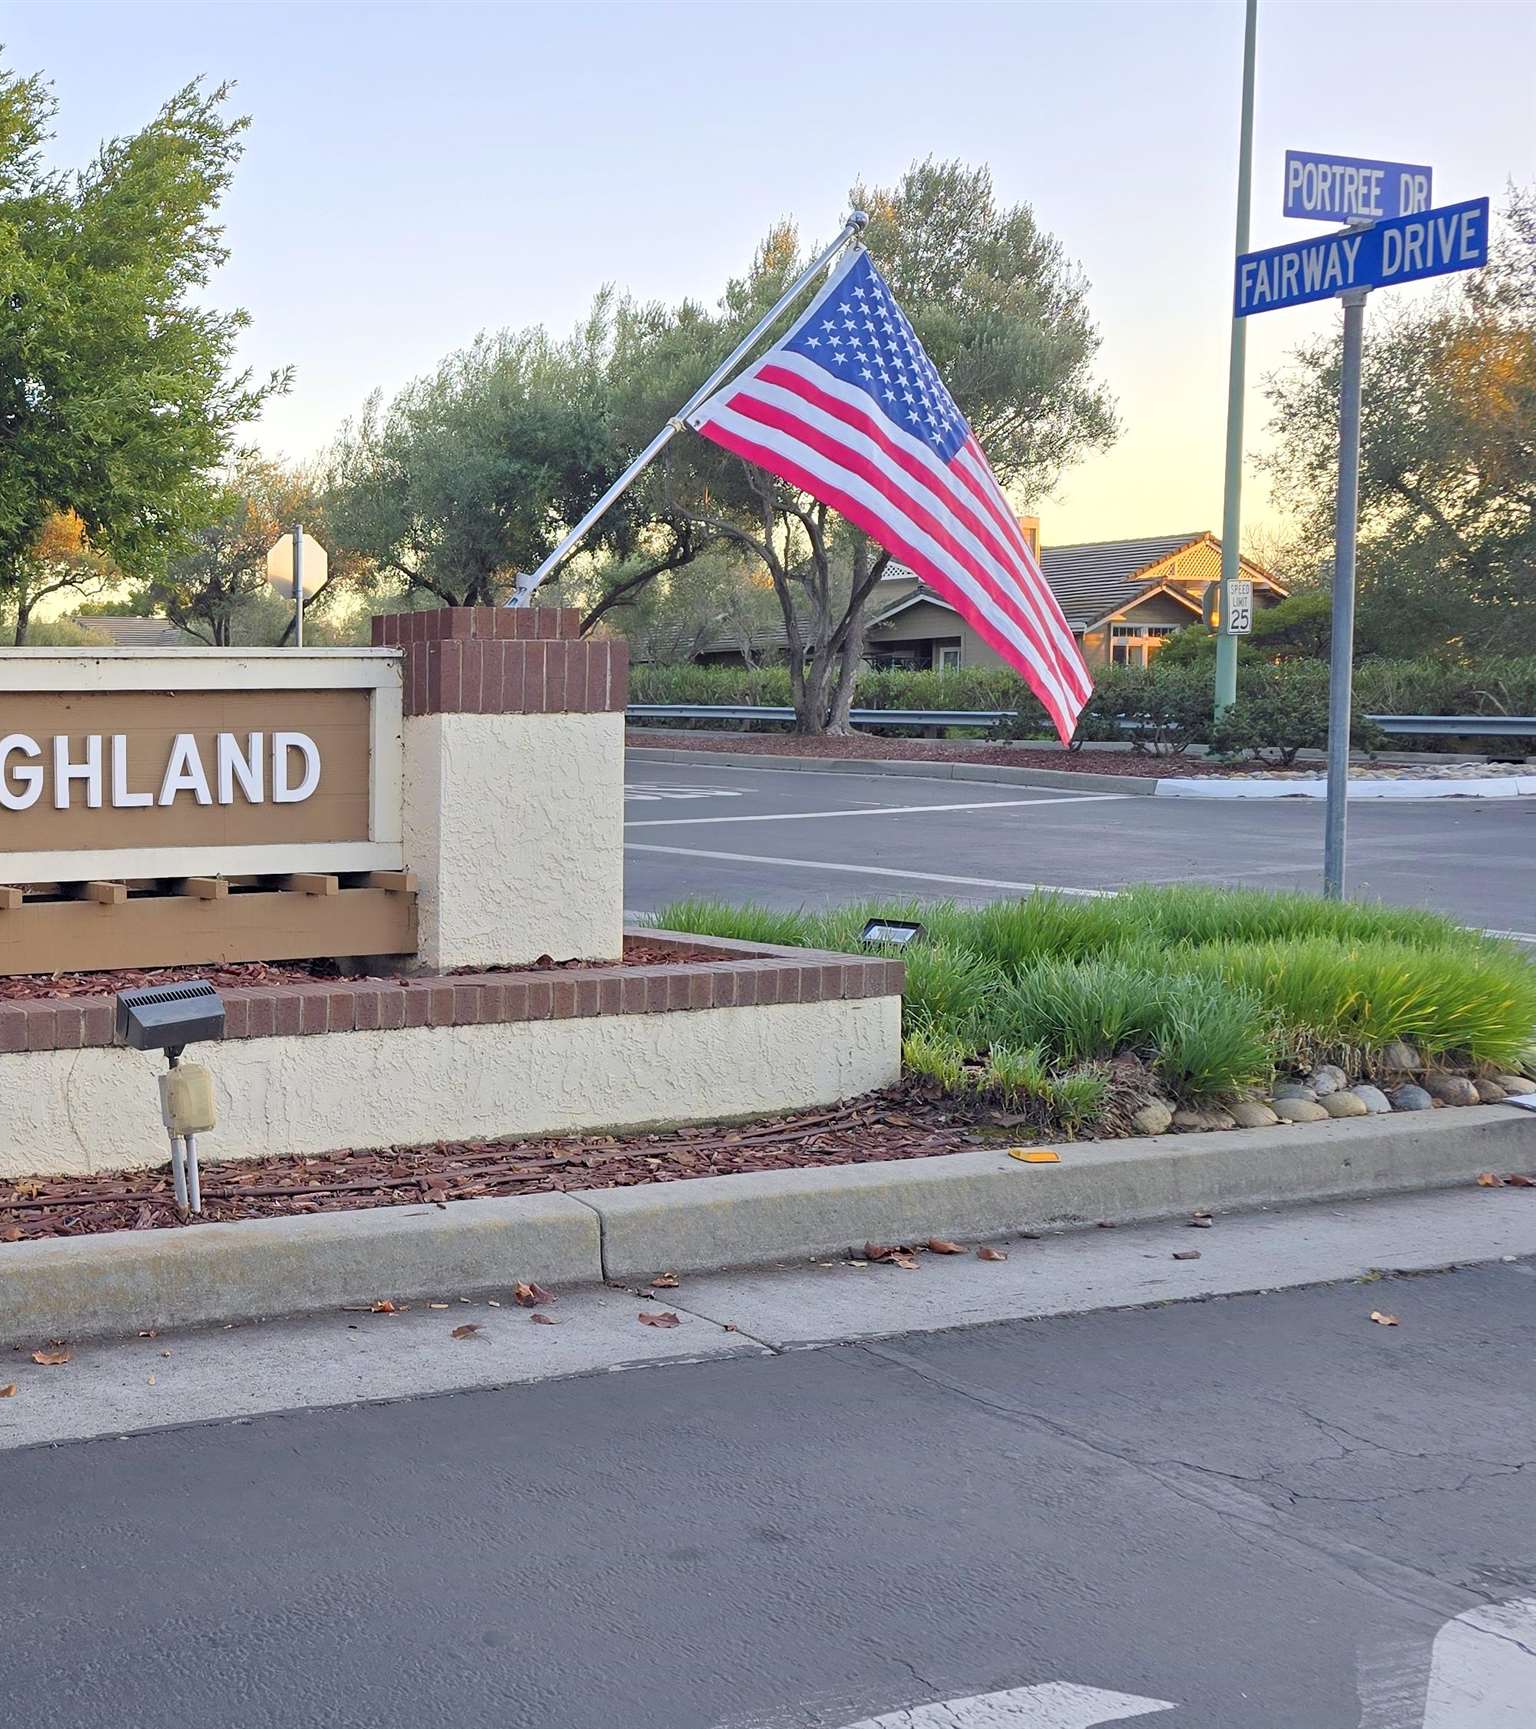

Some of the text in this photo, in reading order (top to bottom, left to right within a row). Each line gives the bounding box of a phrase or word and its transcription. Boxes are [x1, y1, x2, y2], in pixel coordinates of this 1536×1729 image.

[1287, 160, 1428, 217] PORTREE DR
[1240, 208, 1482, 308] FAIRWAY DRIVE
[1231, 584, 1250, 595] SPEED
[1232, 596, 1248, 608] LIMIT
[1231, 608, 1249, 630] 25
